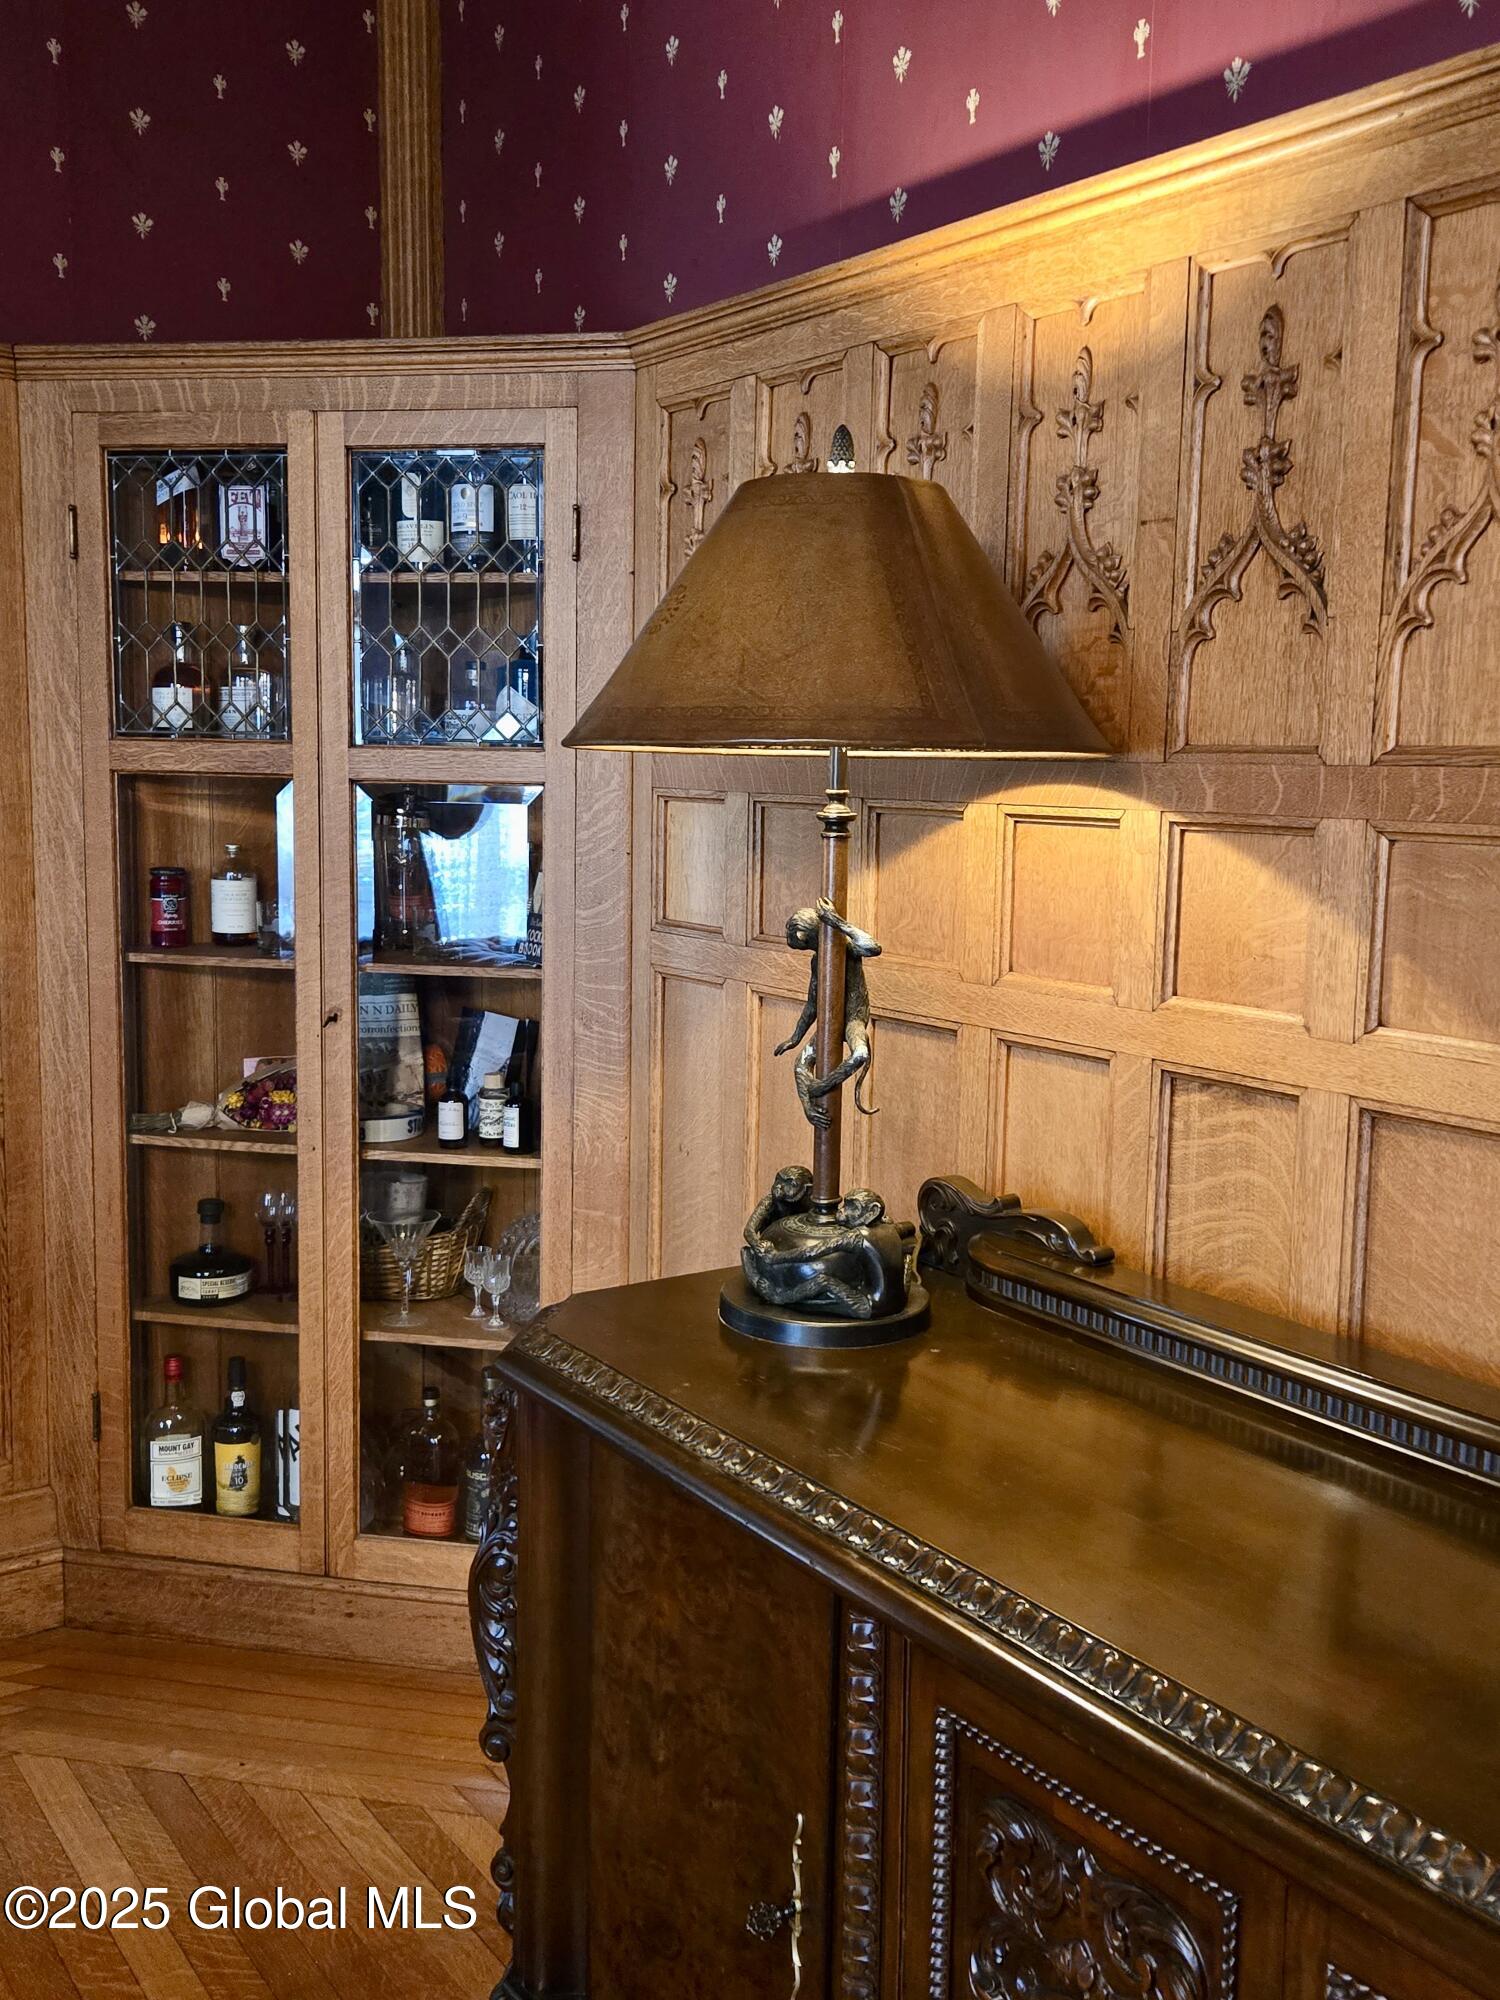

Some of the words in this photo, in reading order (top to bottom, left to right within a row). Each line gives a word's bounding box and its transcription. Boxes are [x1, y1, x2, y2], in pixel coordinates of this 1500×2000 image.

[386, 1003, 418, 1015] DAILY
[158, 1444, 181, 1453] MOUNT
[182, 1442, 195, 1450] GAY
[161, 1472, 193, 1482] ECLIPSE
[235, 1476, 244, 1485] 10
